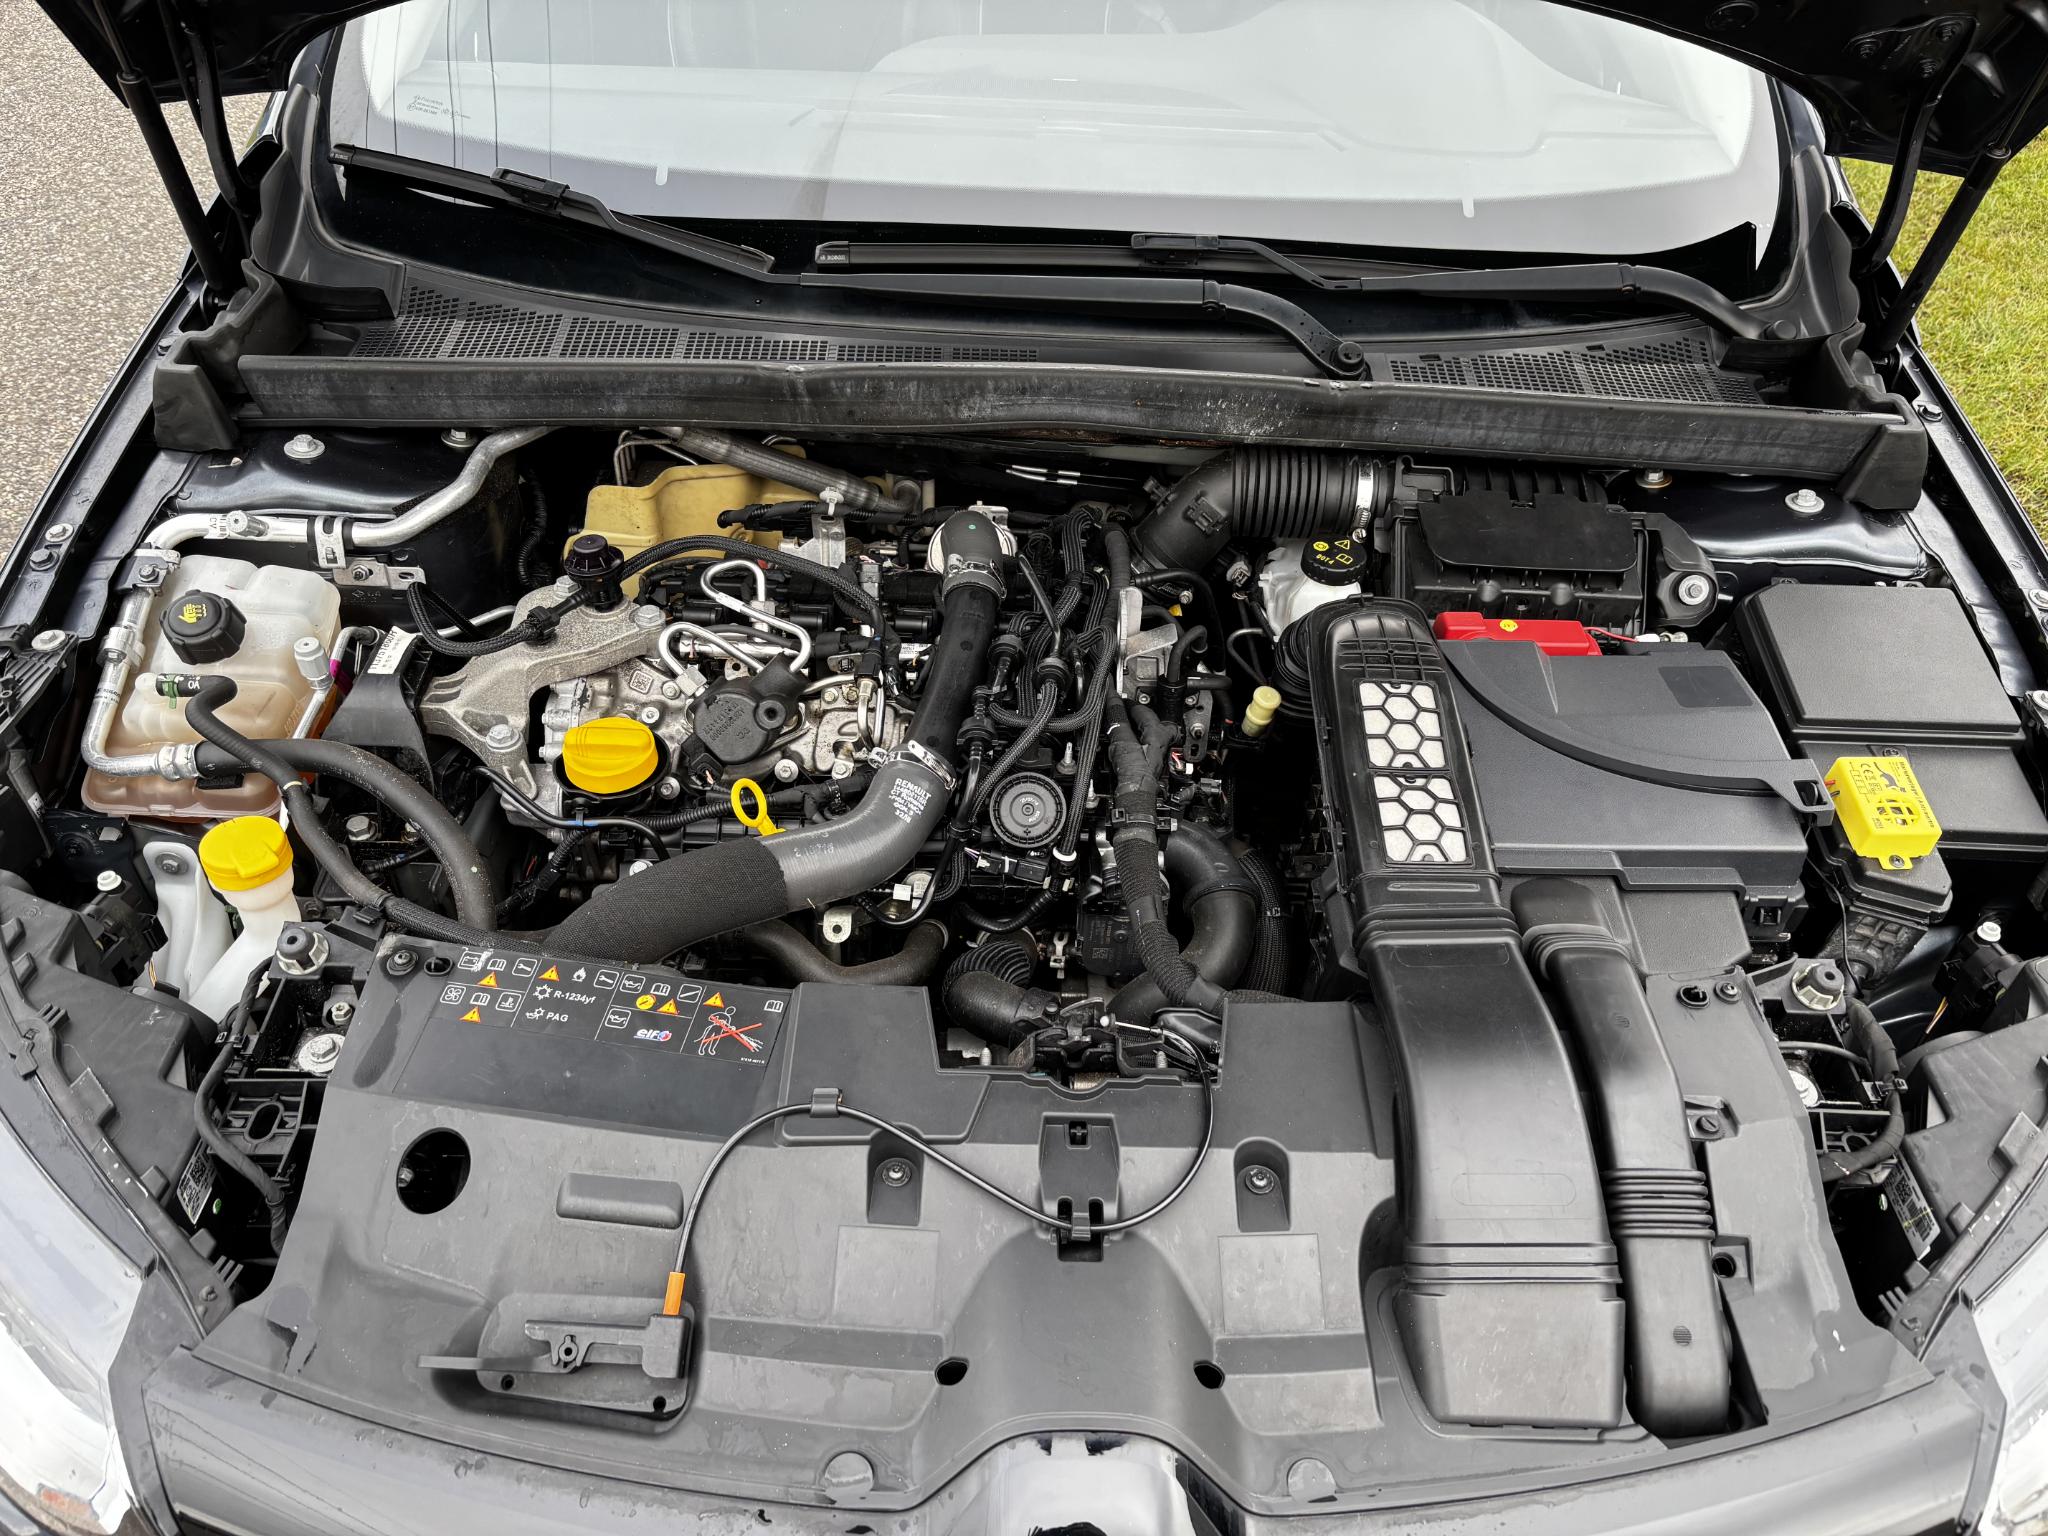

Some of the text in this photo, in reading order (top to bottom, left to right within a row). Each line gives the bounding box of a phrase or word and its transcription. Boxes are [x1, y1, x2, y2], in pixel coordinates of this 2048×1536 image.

[894, 777, 932, 800] RENAULT
[553, 990, 597, 1005] R-1234yf
[546, 1011, 569, 1022] PAG
